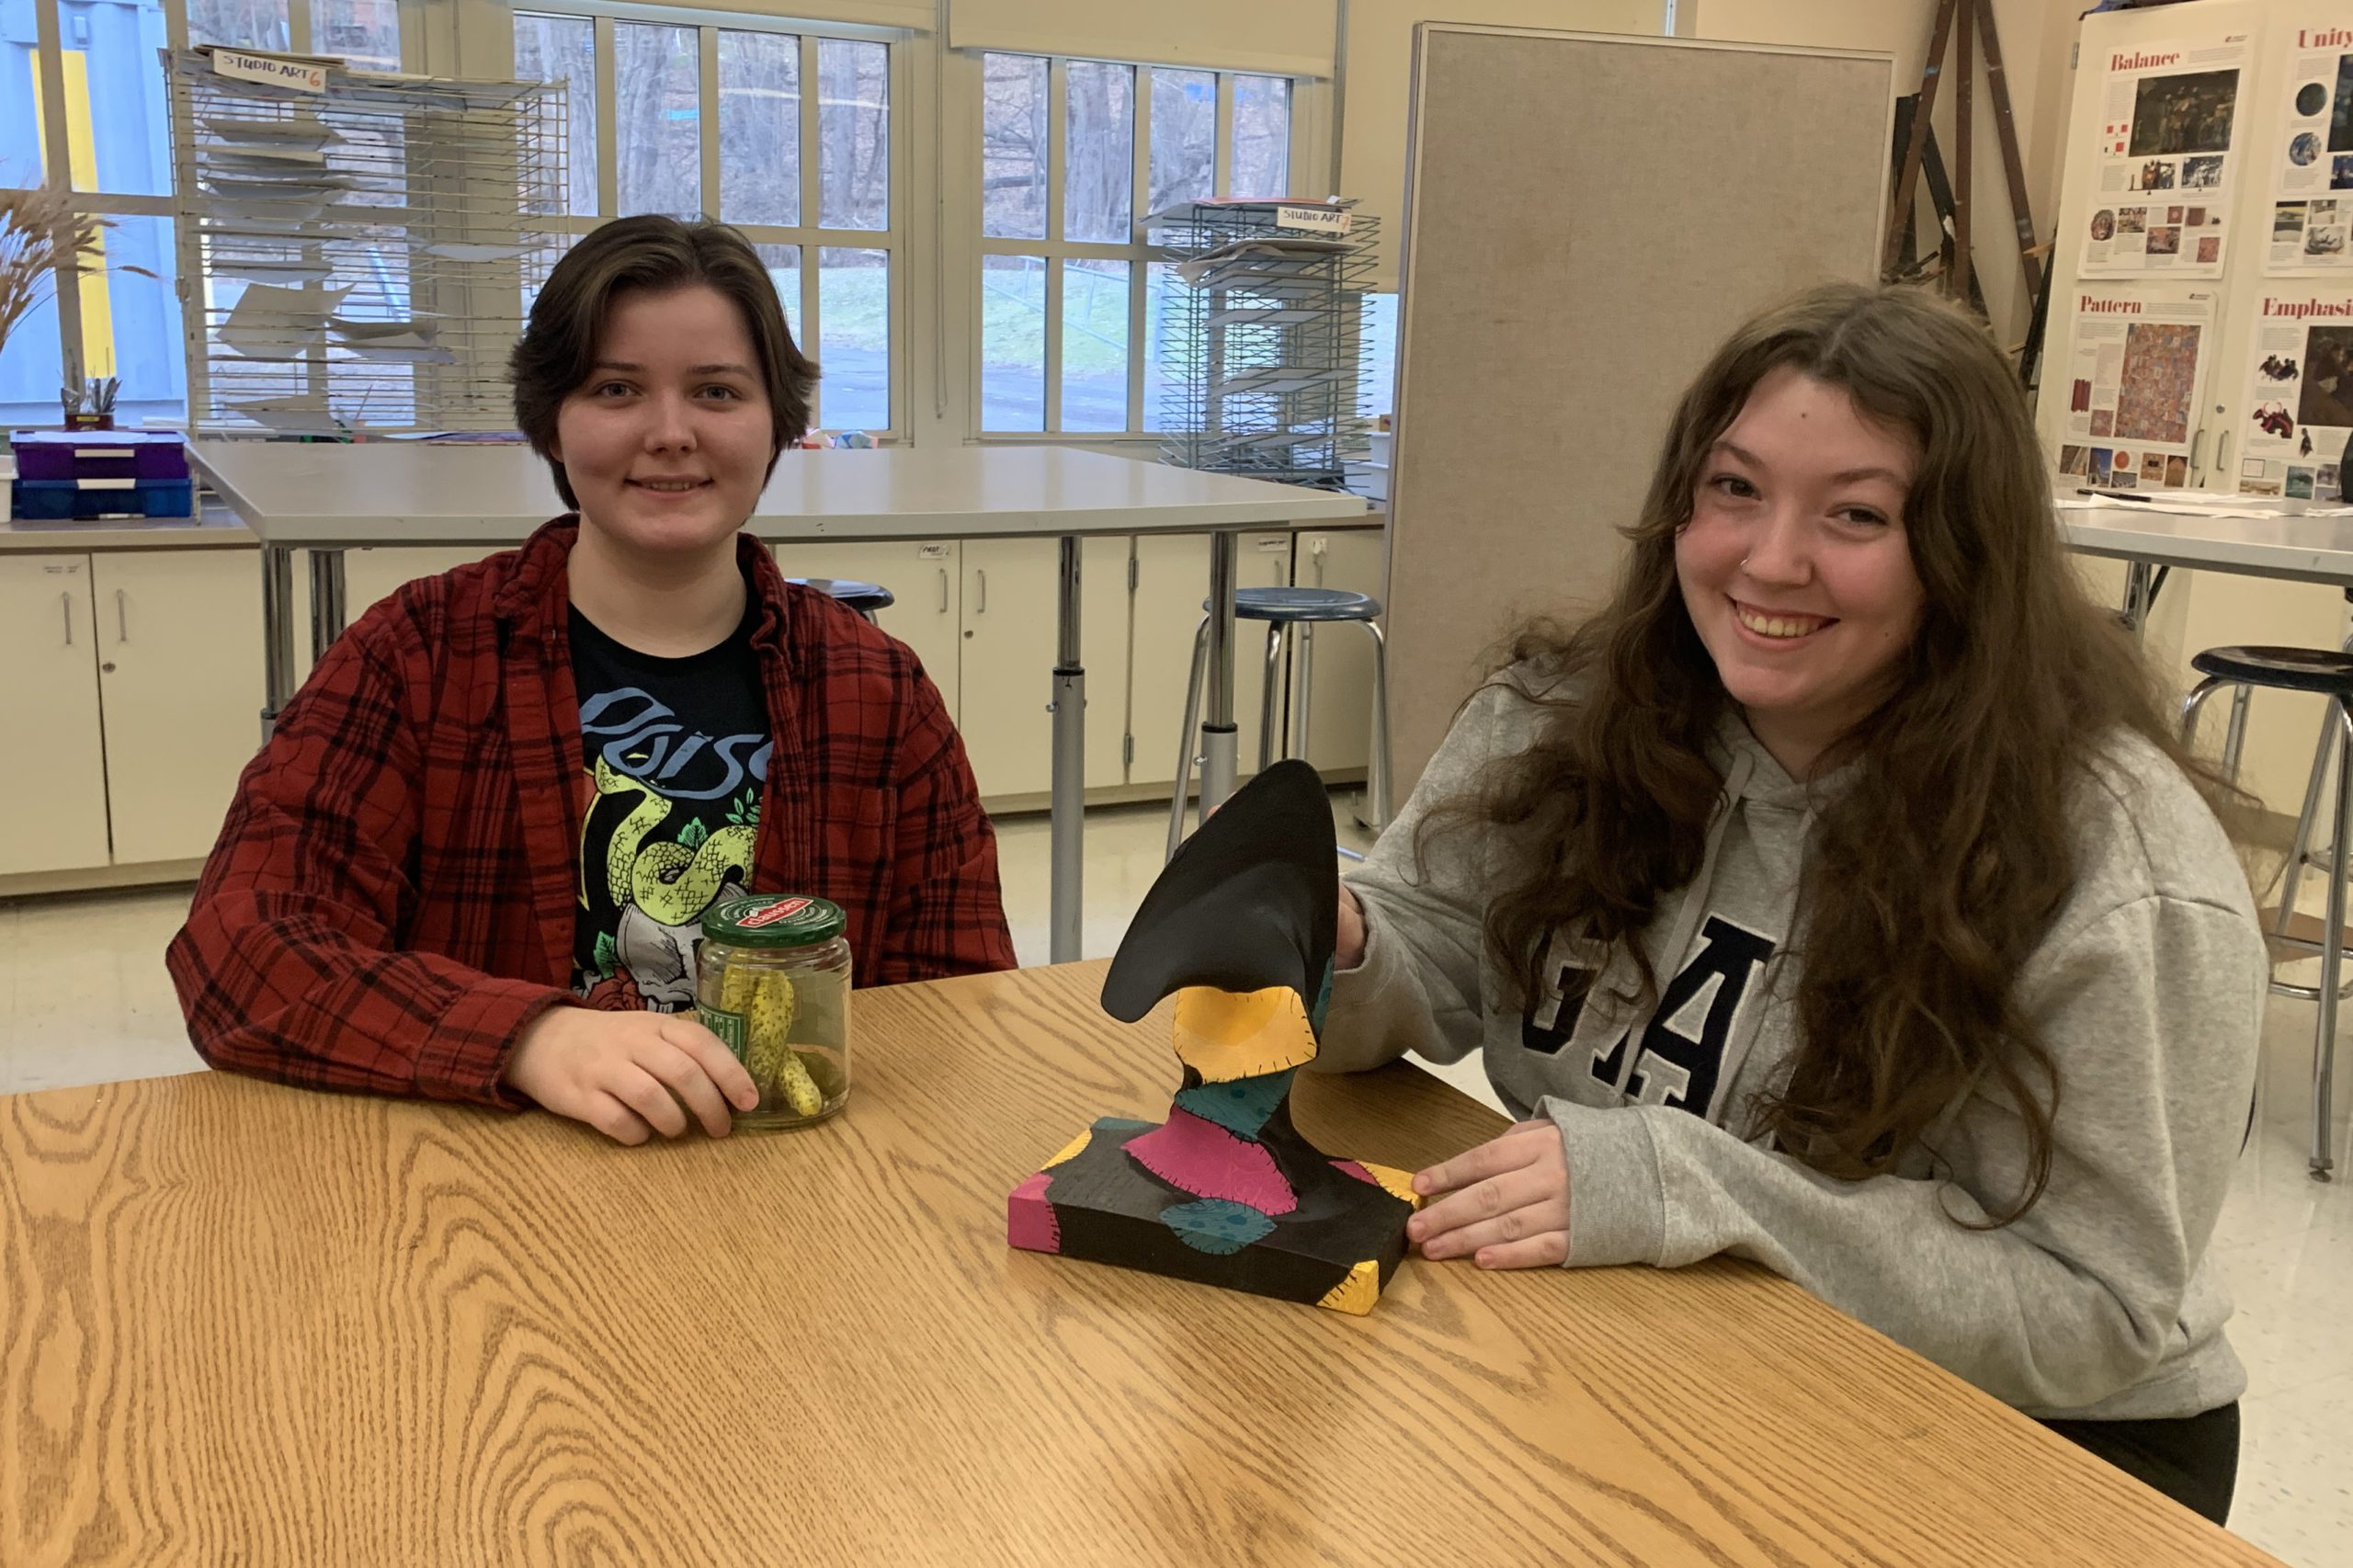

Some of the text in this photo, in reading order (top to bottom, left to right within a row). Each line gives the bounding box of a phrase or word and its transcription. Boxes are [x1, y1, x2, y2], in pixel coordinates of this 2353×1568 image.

[223, 55, 321, 86] STUDIO ART 6
[2110, 51, 2180, 72] Balance
[1283, 210, 1319, 222] STUDIO
[1321, 213, 1342, 223] ART
[2080, 295, 2142, 314] Pattern
[2263, 297, 2353, 320] Emphasi
